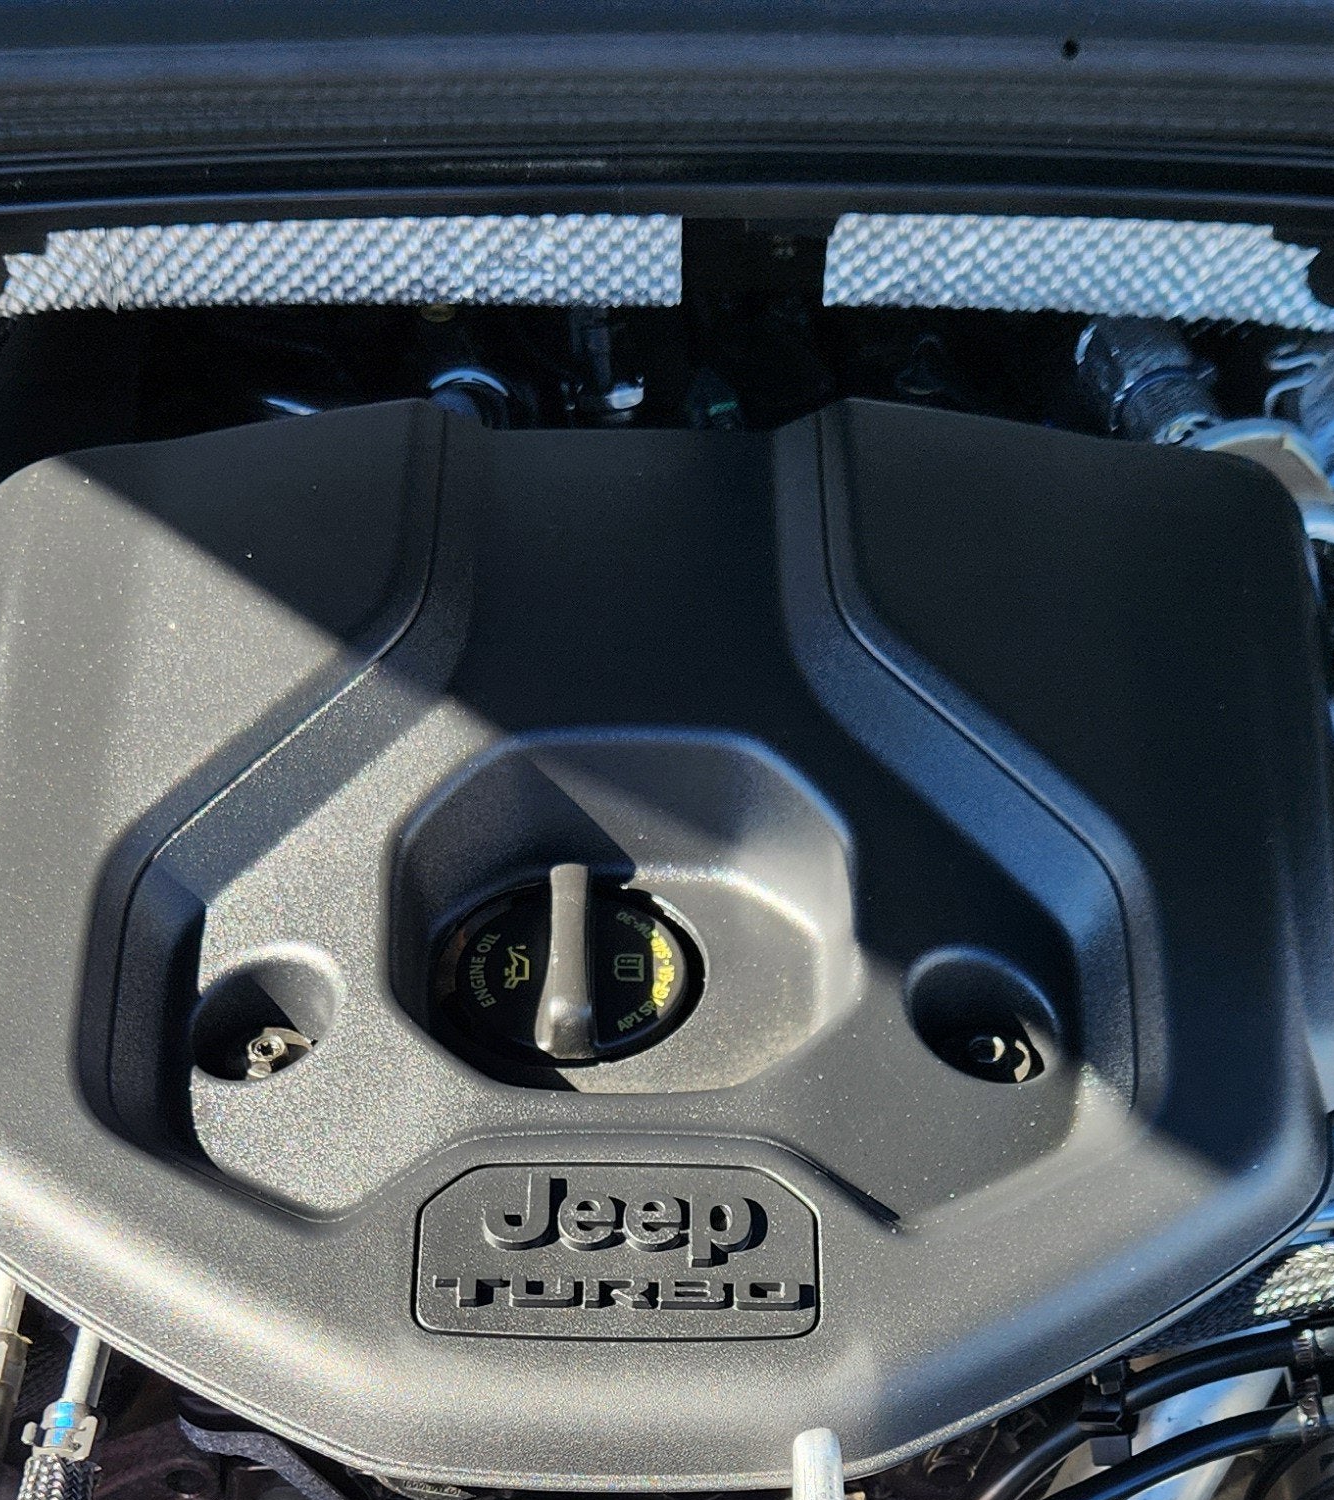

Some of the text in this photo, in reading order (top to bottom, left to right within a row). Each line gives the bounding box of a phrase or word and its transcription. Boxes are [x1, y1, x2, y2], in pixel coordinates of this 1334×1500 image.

[469, 932, 501, 1009] ENGINE OIL
[482, 1173, 759, 1267] Jeep
[432, 1274, 815, 1311] TURBO
